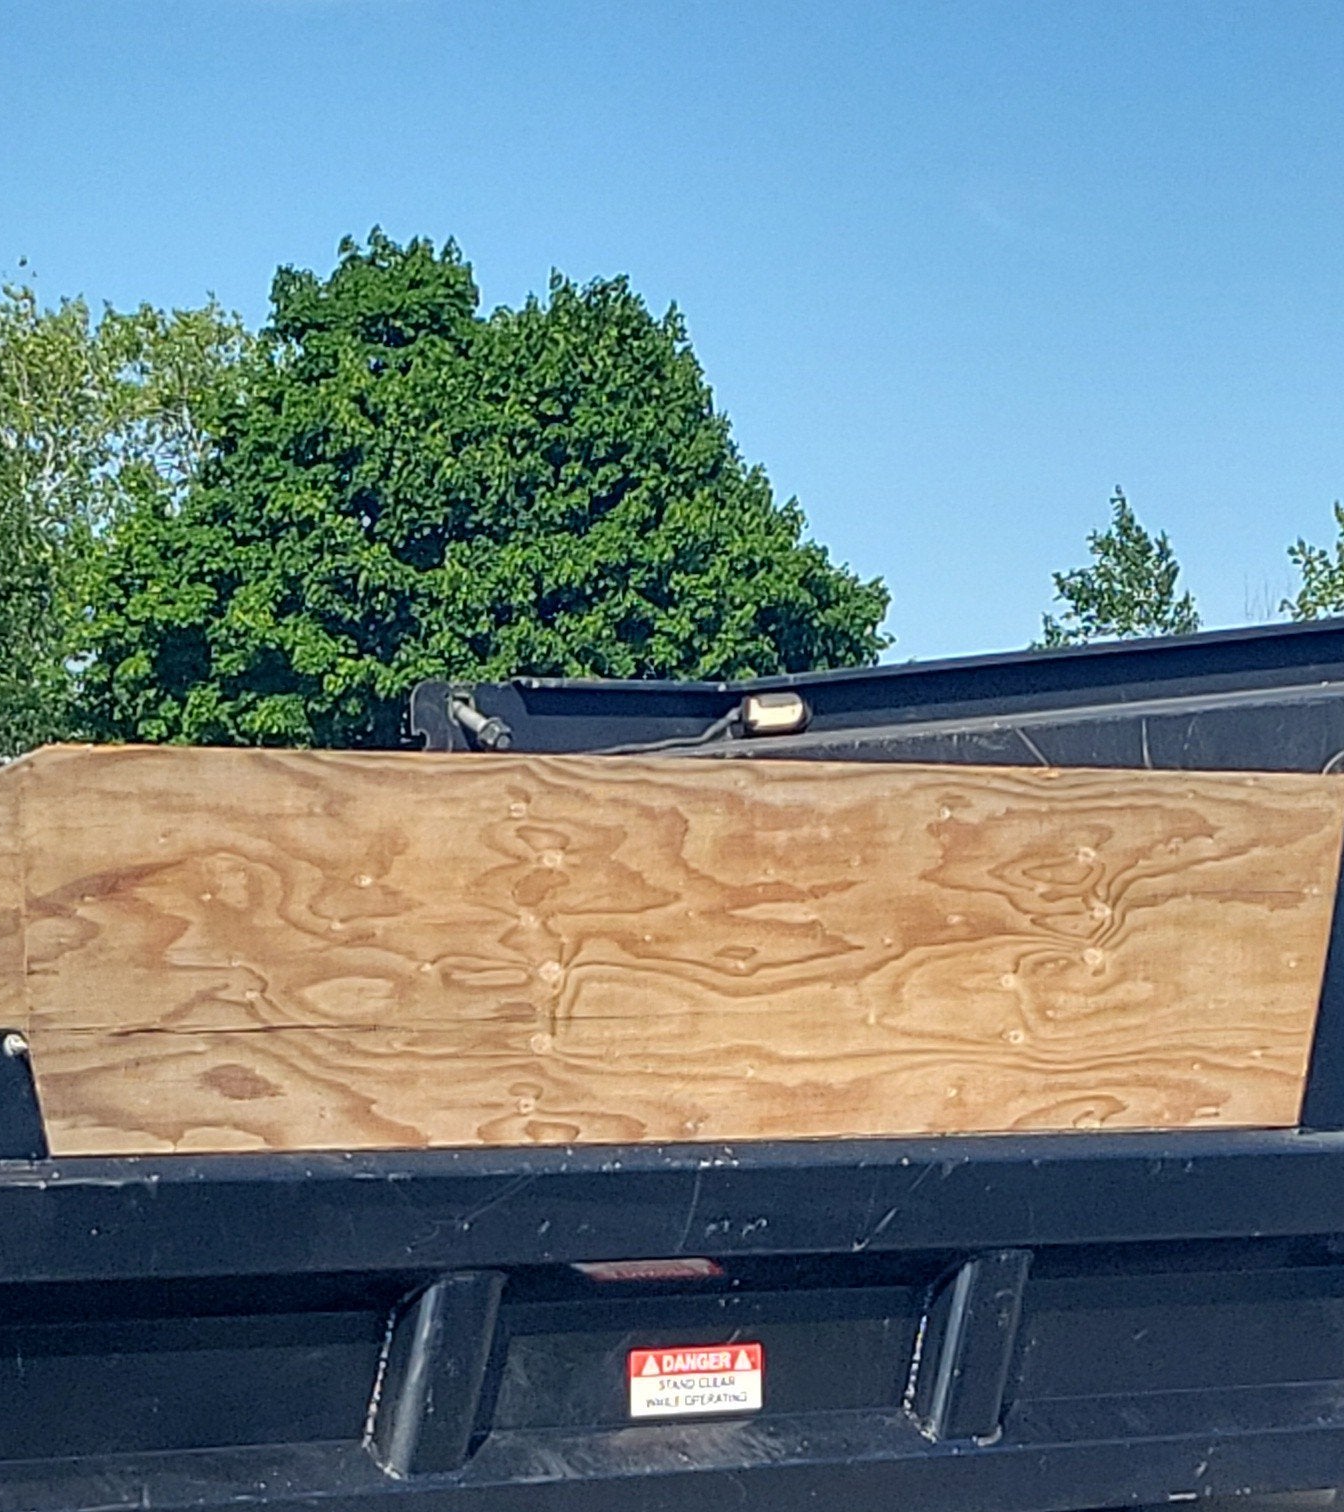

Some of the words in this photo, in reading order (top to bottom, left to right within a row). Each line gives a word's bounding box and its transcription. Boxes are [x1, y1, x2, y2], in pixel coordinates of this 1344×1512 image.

[662, 1352, 731, 1373] DANGER
[659, 1379, 696, 1391] STAND
[698, 1376, 735, 1389] CLEAR
[684, 1391, 747, 1406] OPERATING
